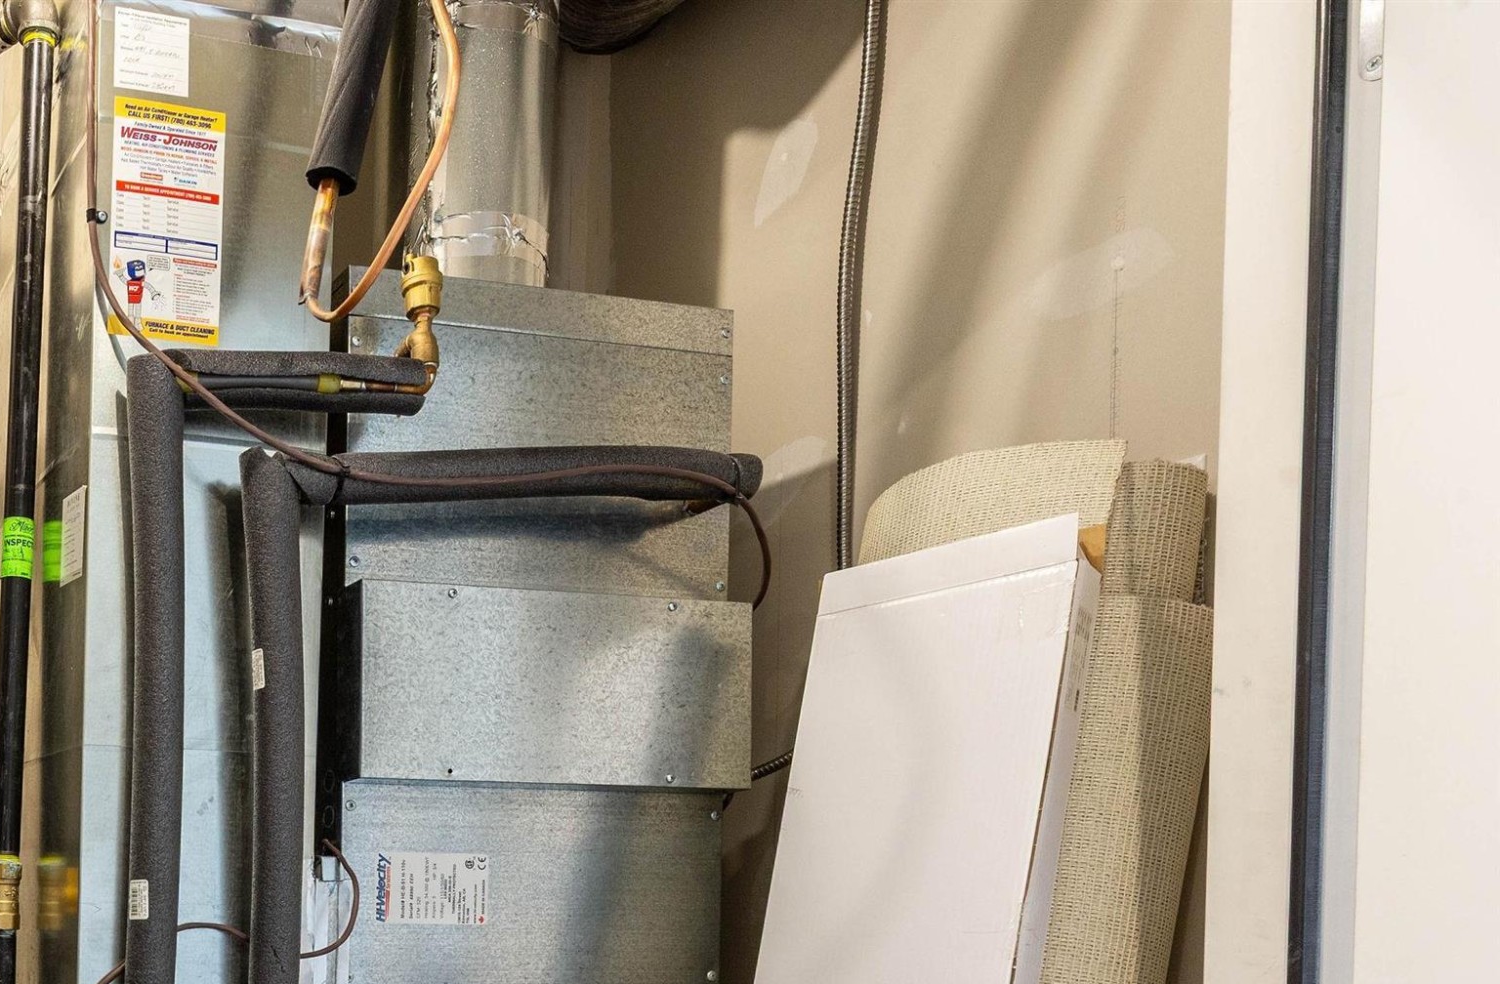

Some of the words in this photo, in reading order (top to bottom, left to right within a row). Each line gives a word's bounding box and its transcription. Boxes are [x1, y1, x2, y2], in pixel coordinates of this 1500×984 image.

[128, 110, 142, 119] CALL
[145, 321, 170, 329] FURNACE
[175, 324, 190, 332] DUCT
[190, 326, 215, 335] CLEANING
